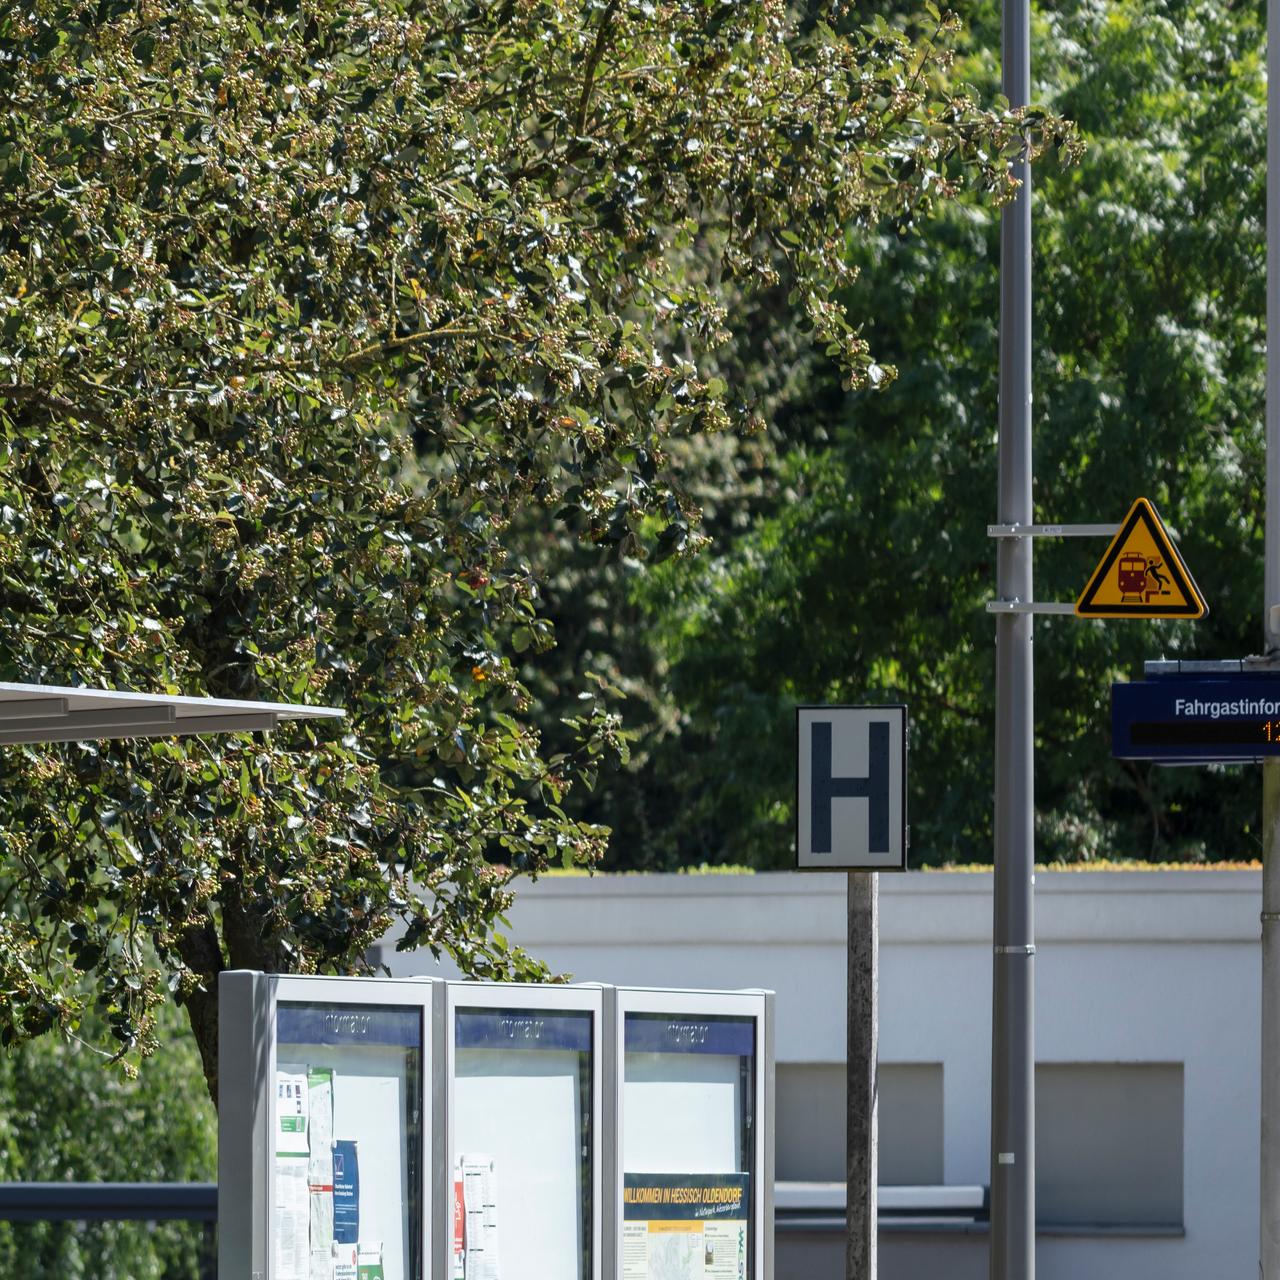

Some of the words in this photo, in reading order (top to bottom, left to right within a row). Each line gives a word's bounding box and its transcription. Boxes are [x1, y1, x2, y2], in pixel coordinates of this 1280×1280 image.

[811, 721, 890, 854] H
[322, 1014, 371, 1034] nformation
[498, 1019, 544, 1040] nformation
[666, 1023, 709, 1043] nformation
[663, 1187, 671, 1203] IN
[671, 1187, 703, 1204] HESSISCH
[702, 1187, 743, 1203] OLDENDORF
